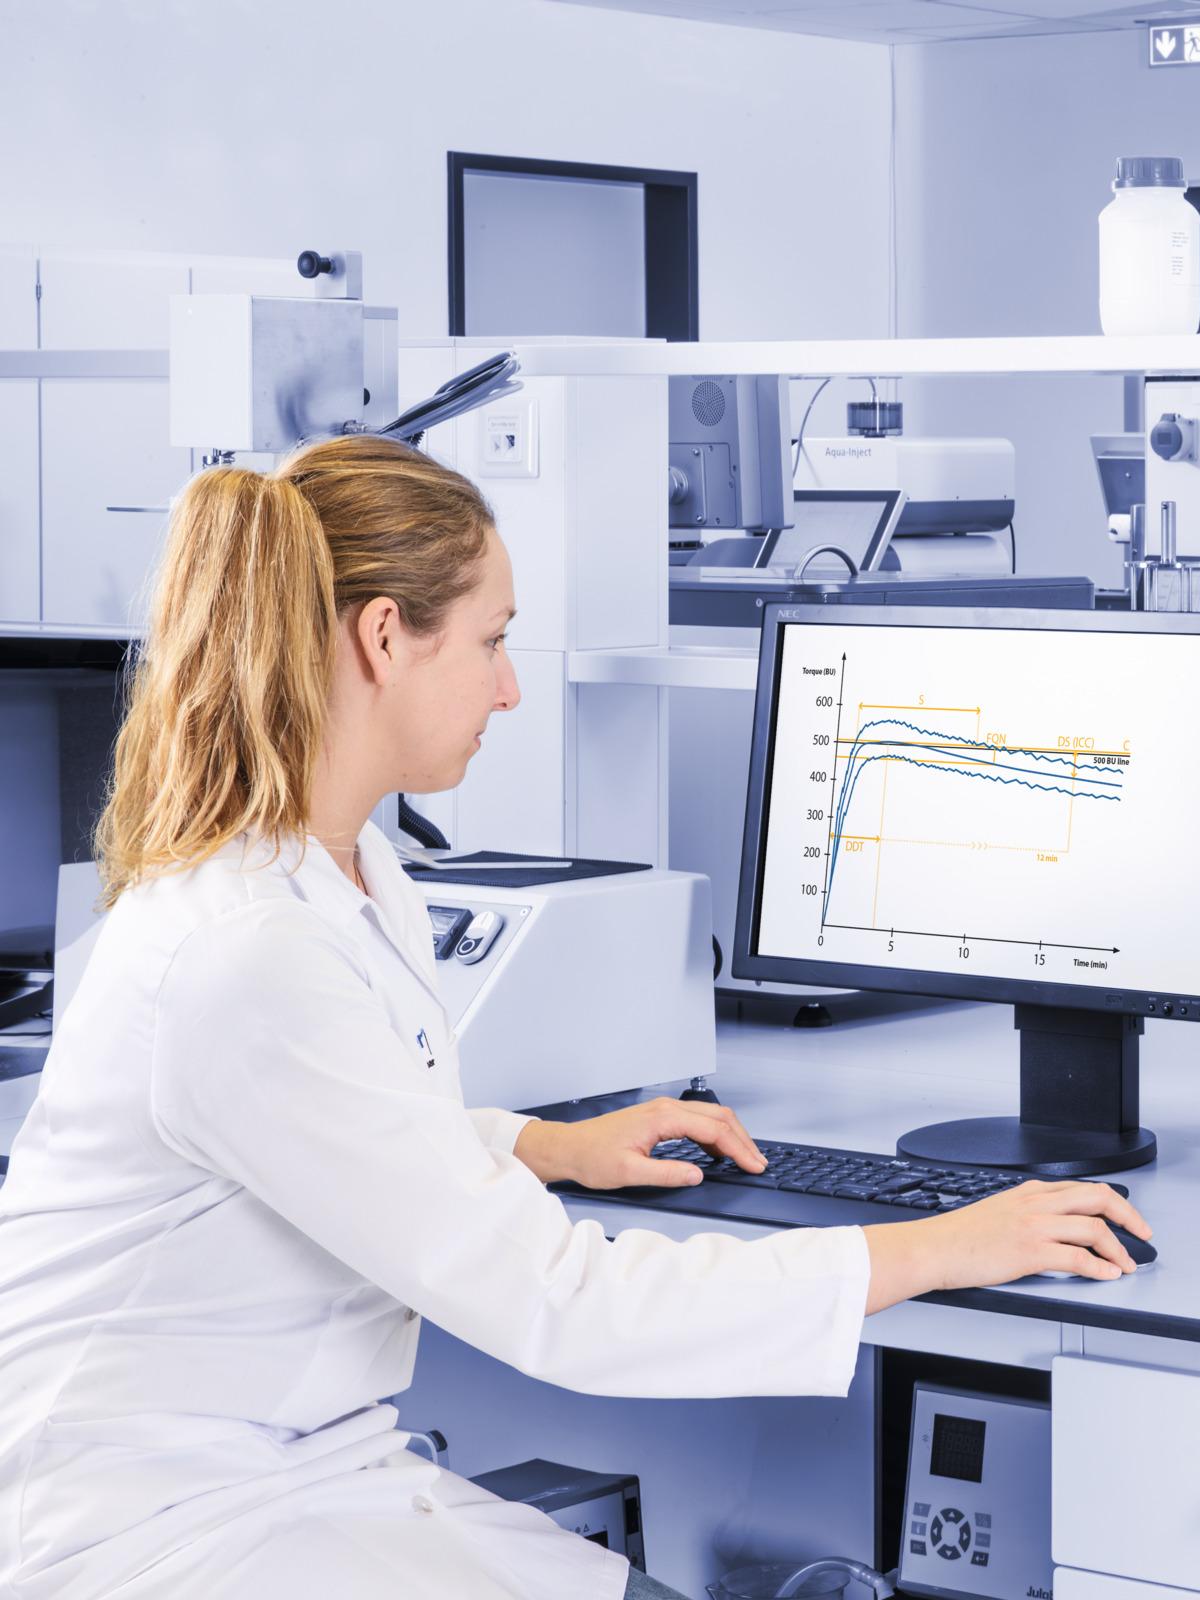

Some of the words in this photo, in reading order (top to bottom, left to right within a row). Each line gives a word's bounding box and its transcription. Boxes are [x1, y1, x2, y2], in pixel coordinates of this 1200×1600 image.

[825, 447, 872, 459] Aqua-Inject
[777, 609, 800, 619] NEC
[802, 667, 823, 676] Torque
[823, 668, 836, 676] (BU)
[816, 696, 833, 707] 600
[918, 694, 924, 706] S
[812, 734, 830, 746] 500
[986, 733, 1007, 745] FQN
[1057, 736, 1070, 747] DS
[1072, 737, 1095, 750] (ICC)
[1123, 740, 1130, 751] C
[1093, 756, 1106, 765] 500
[1106, 757, 1116, 765] BU
[1117, 758, 1130, 766] line
[809, 771, 827, 782] 400
[806, 809, 824, 820] 300
[803, 846, 821, 858] 200
[845, 840, 864, 852] DDT
[1036, 854, 1045, 862] 12
[1045, 854, 1058, 863] min
[801, 884, 818, 896] 100
[818, 936, 824, 946] 0
[888, 941, 894, 952] 5
[958, 946, 970, 959] 10
[1034, 953, 1046, 966] 15
[1073, 958, 1090, 968] Time
[1090, 960, 1108, 970] (min)
